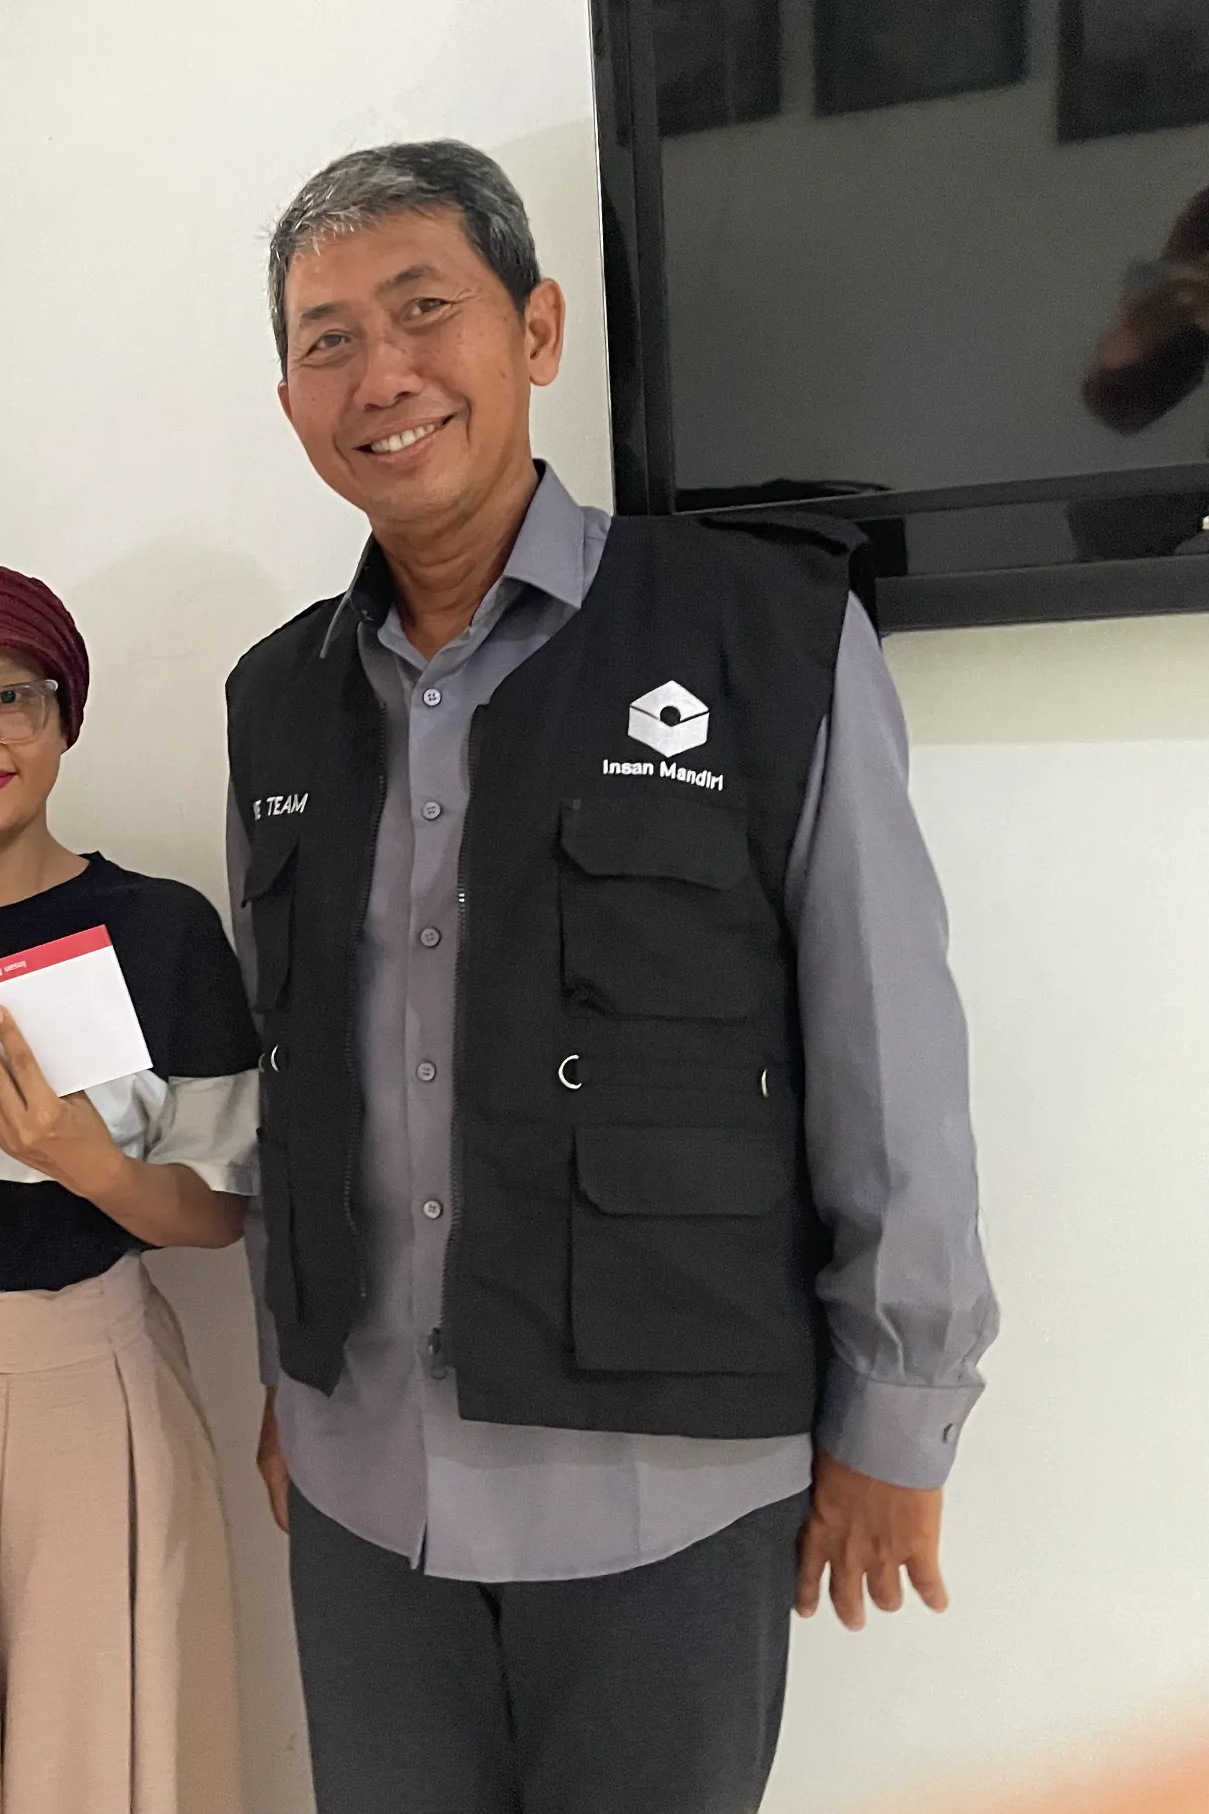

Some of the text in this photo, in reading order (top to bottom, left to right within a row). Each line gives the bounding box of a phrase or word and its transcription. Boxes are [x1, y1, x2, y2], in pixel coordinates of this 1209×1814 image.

[602, 759, 724, 791] Insan Mandiri
[266, 792, 309, 816] TEAM
[4, 960, 27, 972] Insan
